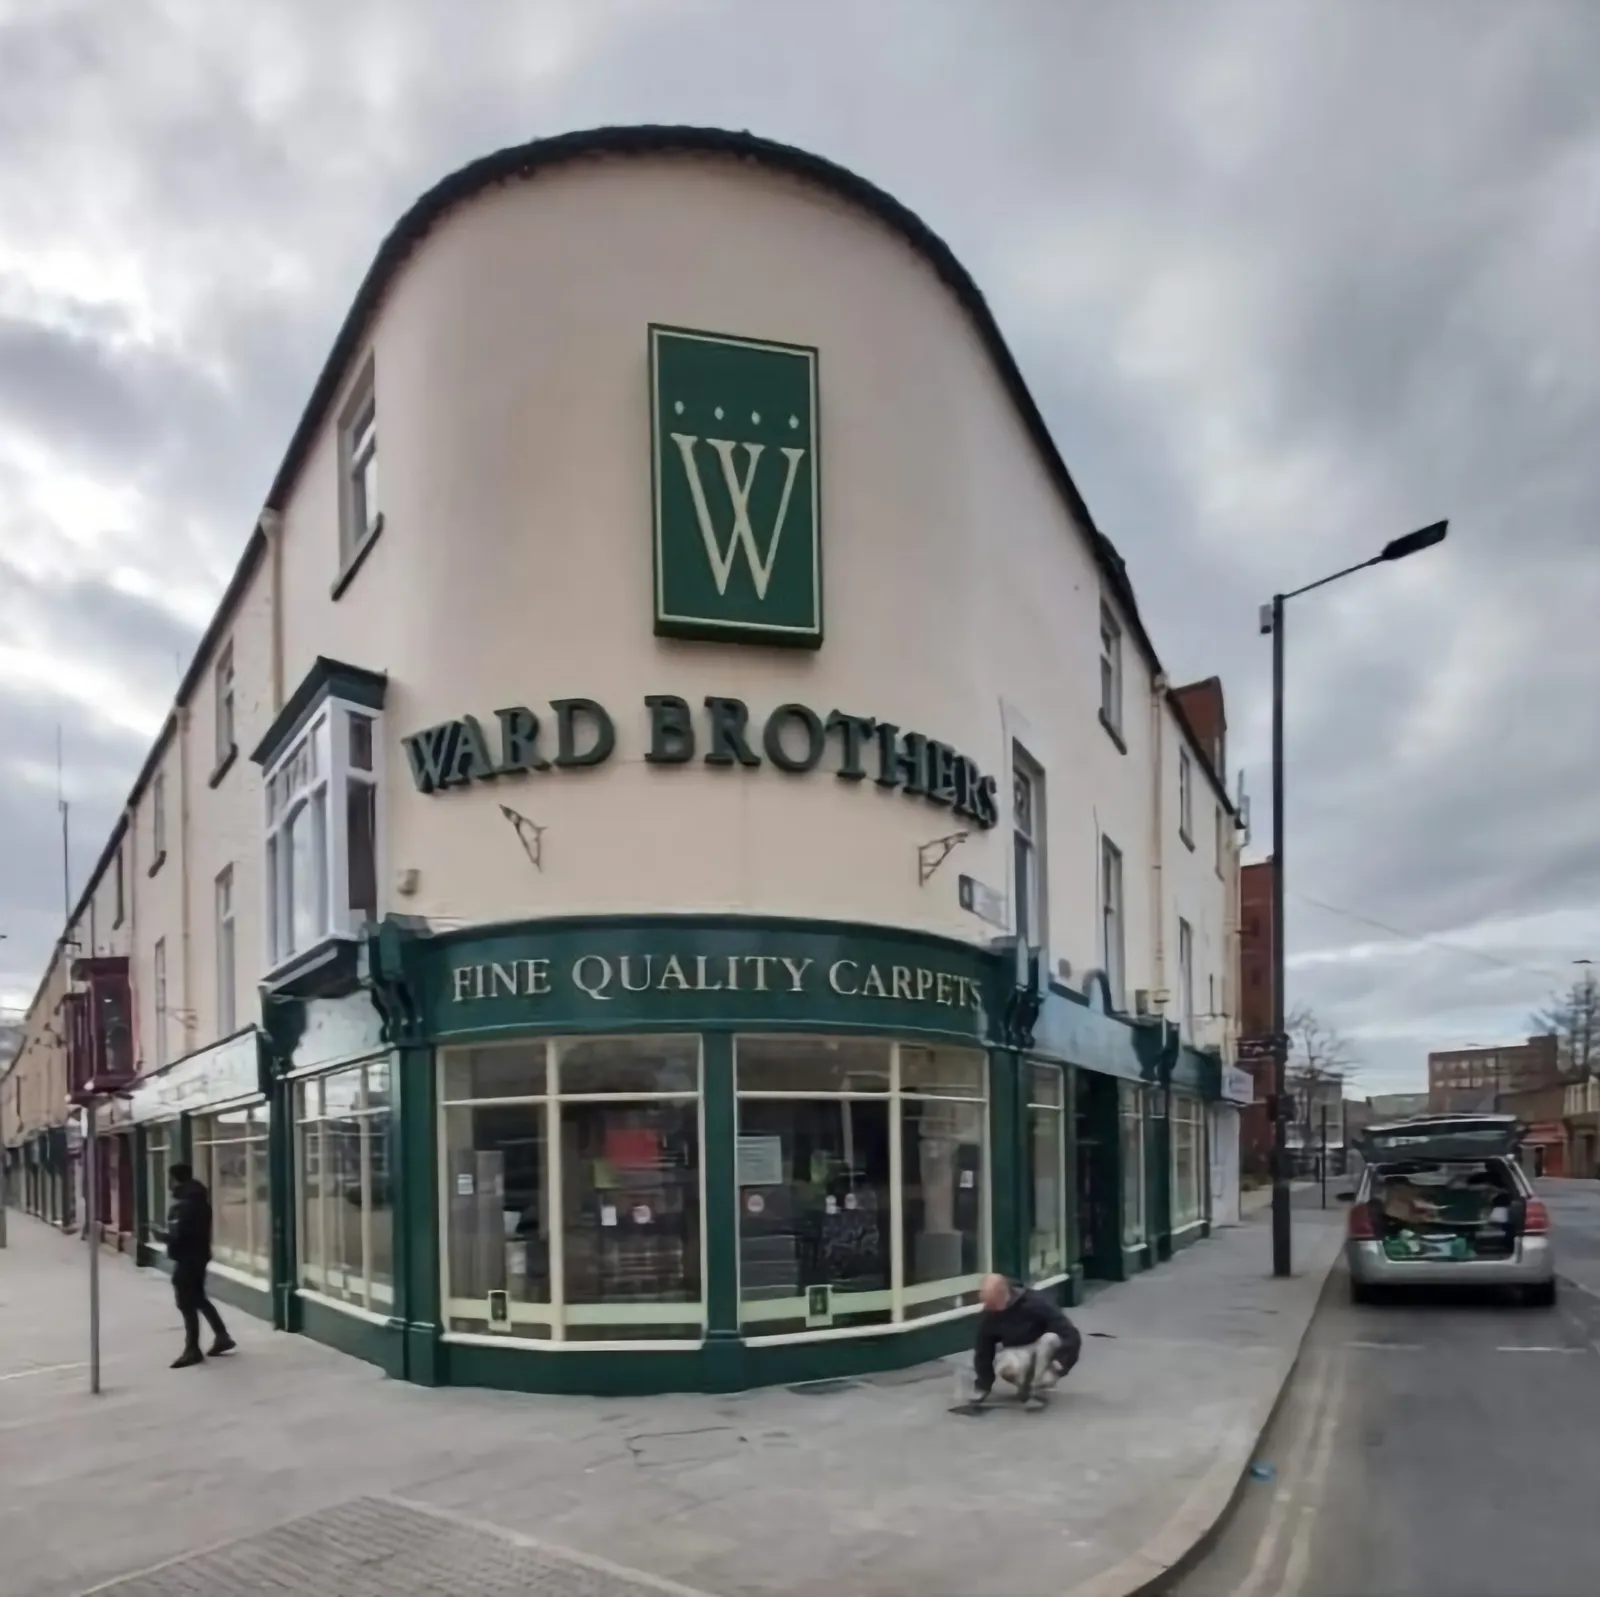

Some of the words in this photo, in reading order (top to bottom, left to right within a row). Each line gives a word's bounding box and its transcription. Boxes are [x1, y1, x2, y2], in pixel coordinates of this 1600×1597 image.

[670, 433, 805, 600] W
[401, 698, 616, 793] WARD
[644, 695, 998, 830] BROTHERS
[452, 959, 552, 1002] FINE
[572, 954, 814, 1000] QUALITY
[829, 959, 982, 1011] CARPETS
